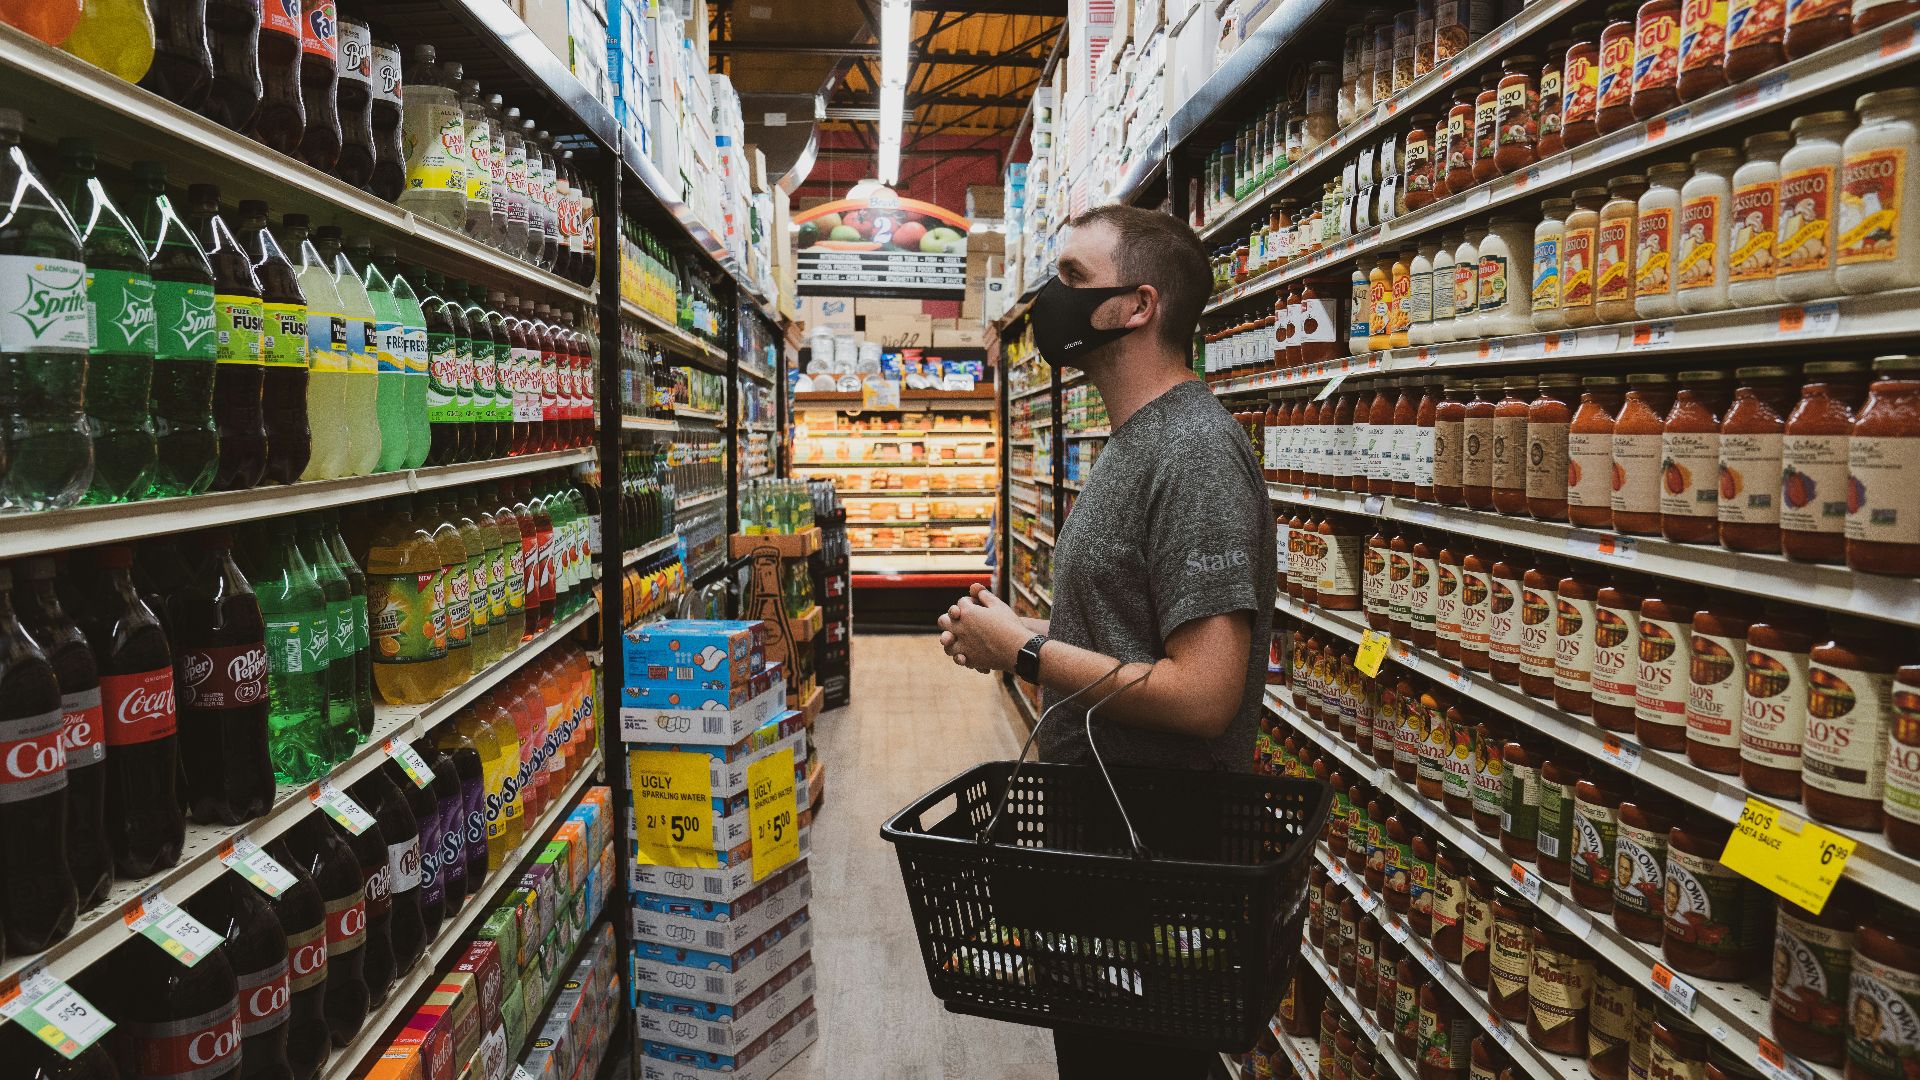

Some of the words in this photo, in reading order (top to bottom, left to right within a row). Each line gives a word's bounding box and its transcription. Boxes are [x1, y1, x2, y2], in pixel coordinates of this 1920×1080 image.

[872, 216, 893, 243] 2
[246, 650, 261, 666] Dr
[243, 686, 254, 697] 23
[641, 775, 672, 789] UGLY
[753, 780, 772, 800] UGLY
[641, 789, 680, 801] SPARKLING
[680, 793, 706, 802] WATER
[1741, 807, 1773, 830] RAO'S
[1583, 824, 1600, 855] OWN
[1735, 823, 1758, 839] PASTA
[1758, 834, 1783, 850] SAUCE
[1638, 853, 1659, 884] OWN
[1685, 880, 1706, 914] OWN
[1797, 950, 1822, 987] OWN
